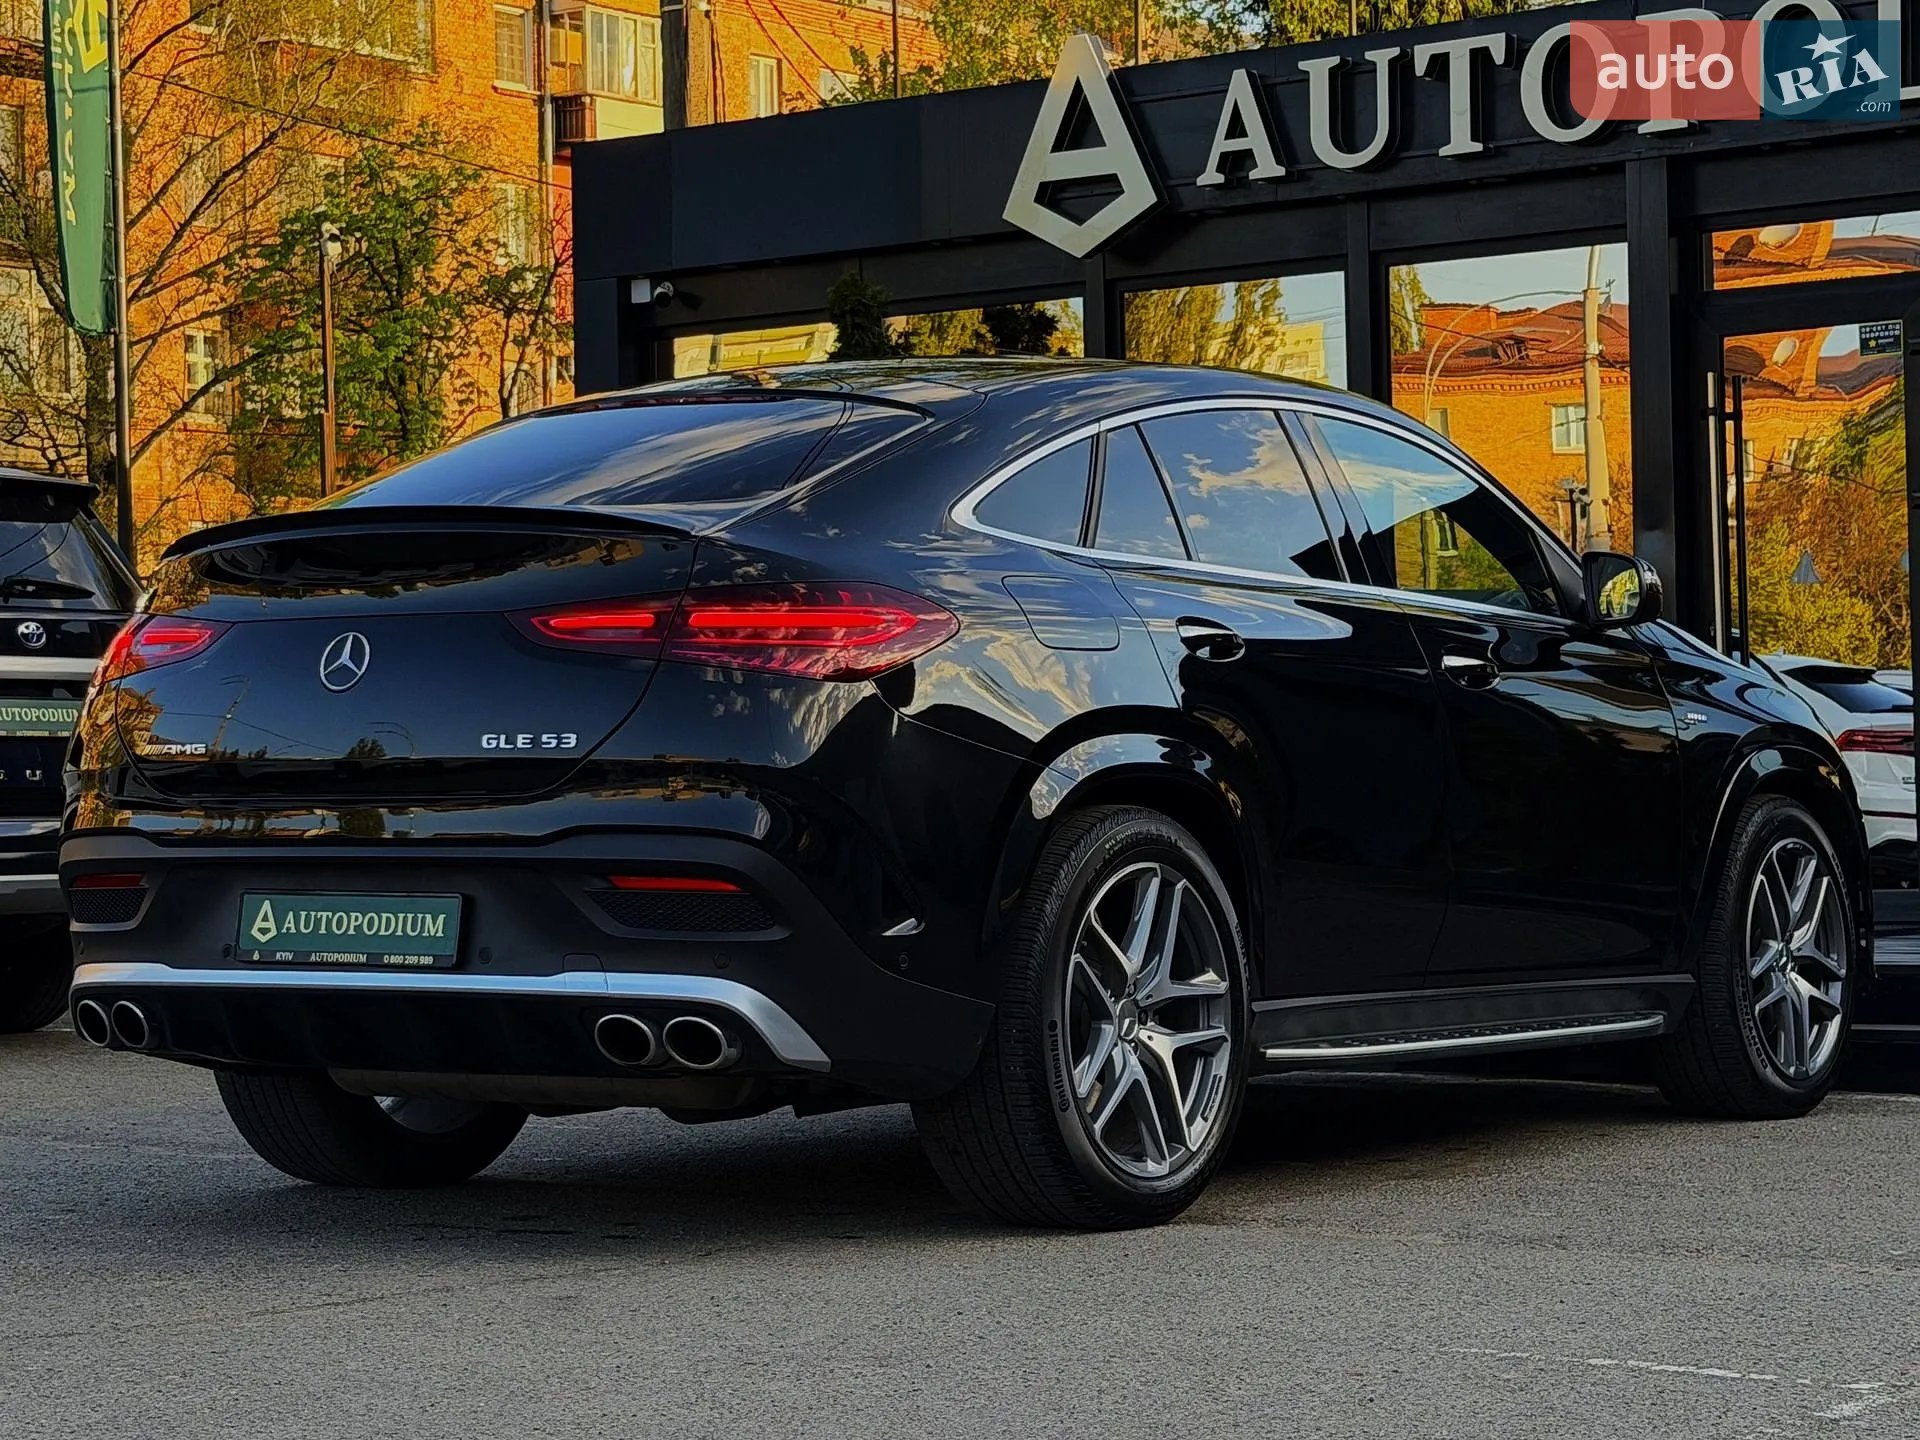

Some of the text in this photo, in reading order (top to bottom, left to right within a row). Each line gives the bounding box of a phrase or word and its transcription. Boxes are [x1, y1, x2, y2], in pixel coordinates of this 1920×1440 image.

[481, 733, 578, 749] GLE 53
[161, 743, 206, 755] AMG
[281, 910, 447, 938] AUTOPODIUM
[275, 951, 294, 961] KYIV
[310, 952, 368, 964] AUTOPODIUM
